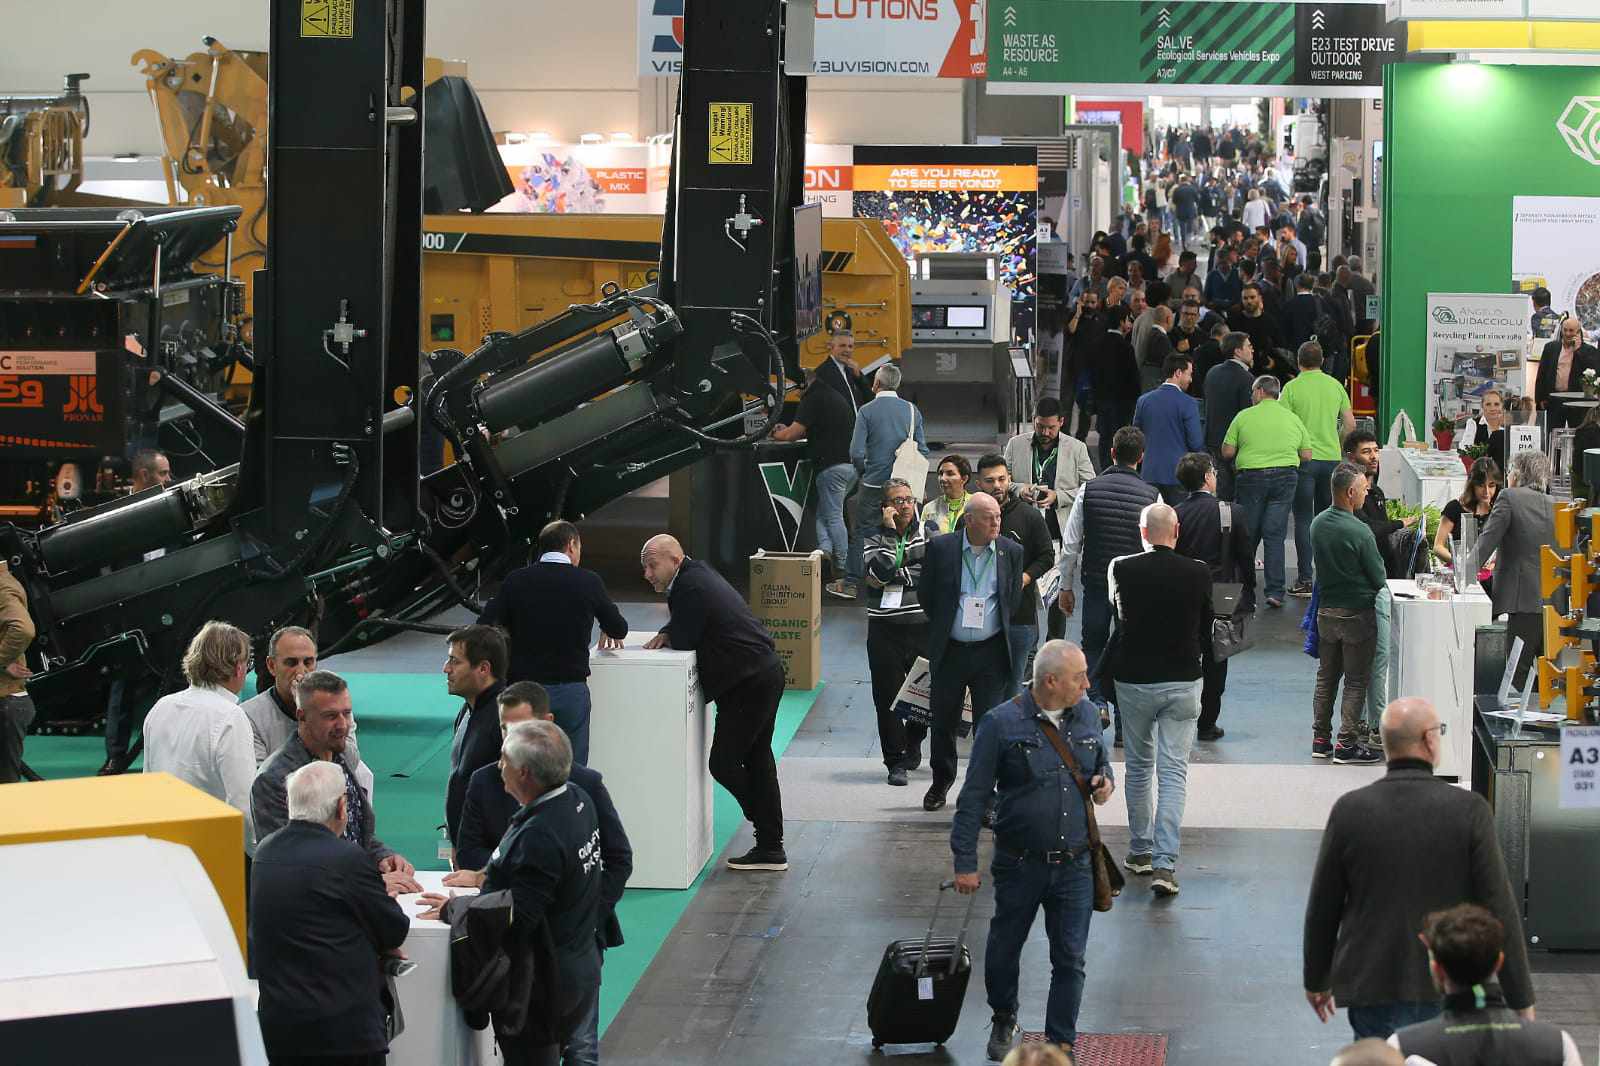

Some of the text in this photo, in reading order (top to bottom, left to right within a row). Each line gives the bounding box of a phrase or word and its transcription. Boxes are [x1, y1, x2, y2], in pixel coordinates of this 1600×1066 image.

[1003, 34, 1056, 47] WASTE AS
[1157, 36, 1192, 49] SAL.VE
[1311, 37, 1396, 51] E23 TEST DRIVE
[1003, 48, 1059, 62] RESOURCE
[1157, 50, 1280, 63] Ecological Services Vehicles Expo
[1311, 52, 1362, 65] OUTDOOR
[1310, 70, 1363, 80] WEST PARKING
[596, 171, 645, 180] PLASTIC
[890, 169, 999, 178] ARE YOU READY
[609, 183, 630, 191] MIX
[888, 179, 1002, 189] TO SEE BEYOND?
[806, 195, 837, 203] HING
[422, 233, 445, 249] 00
[1433, 331, 1467, 341] Recycling
[1468, 332, 1486, 340] Plant
[1487, 333, 1505, 341] since
[760, 591, 805, 599] EXHIBITION
[1570, 747, 1599, 765] A3
